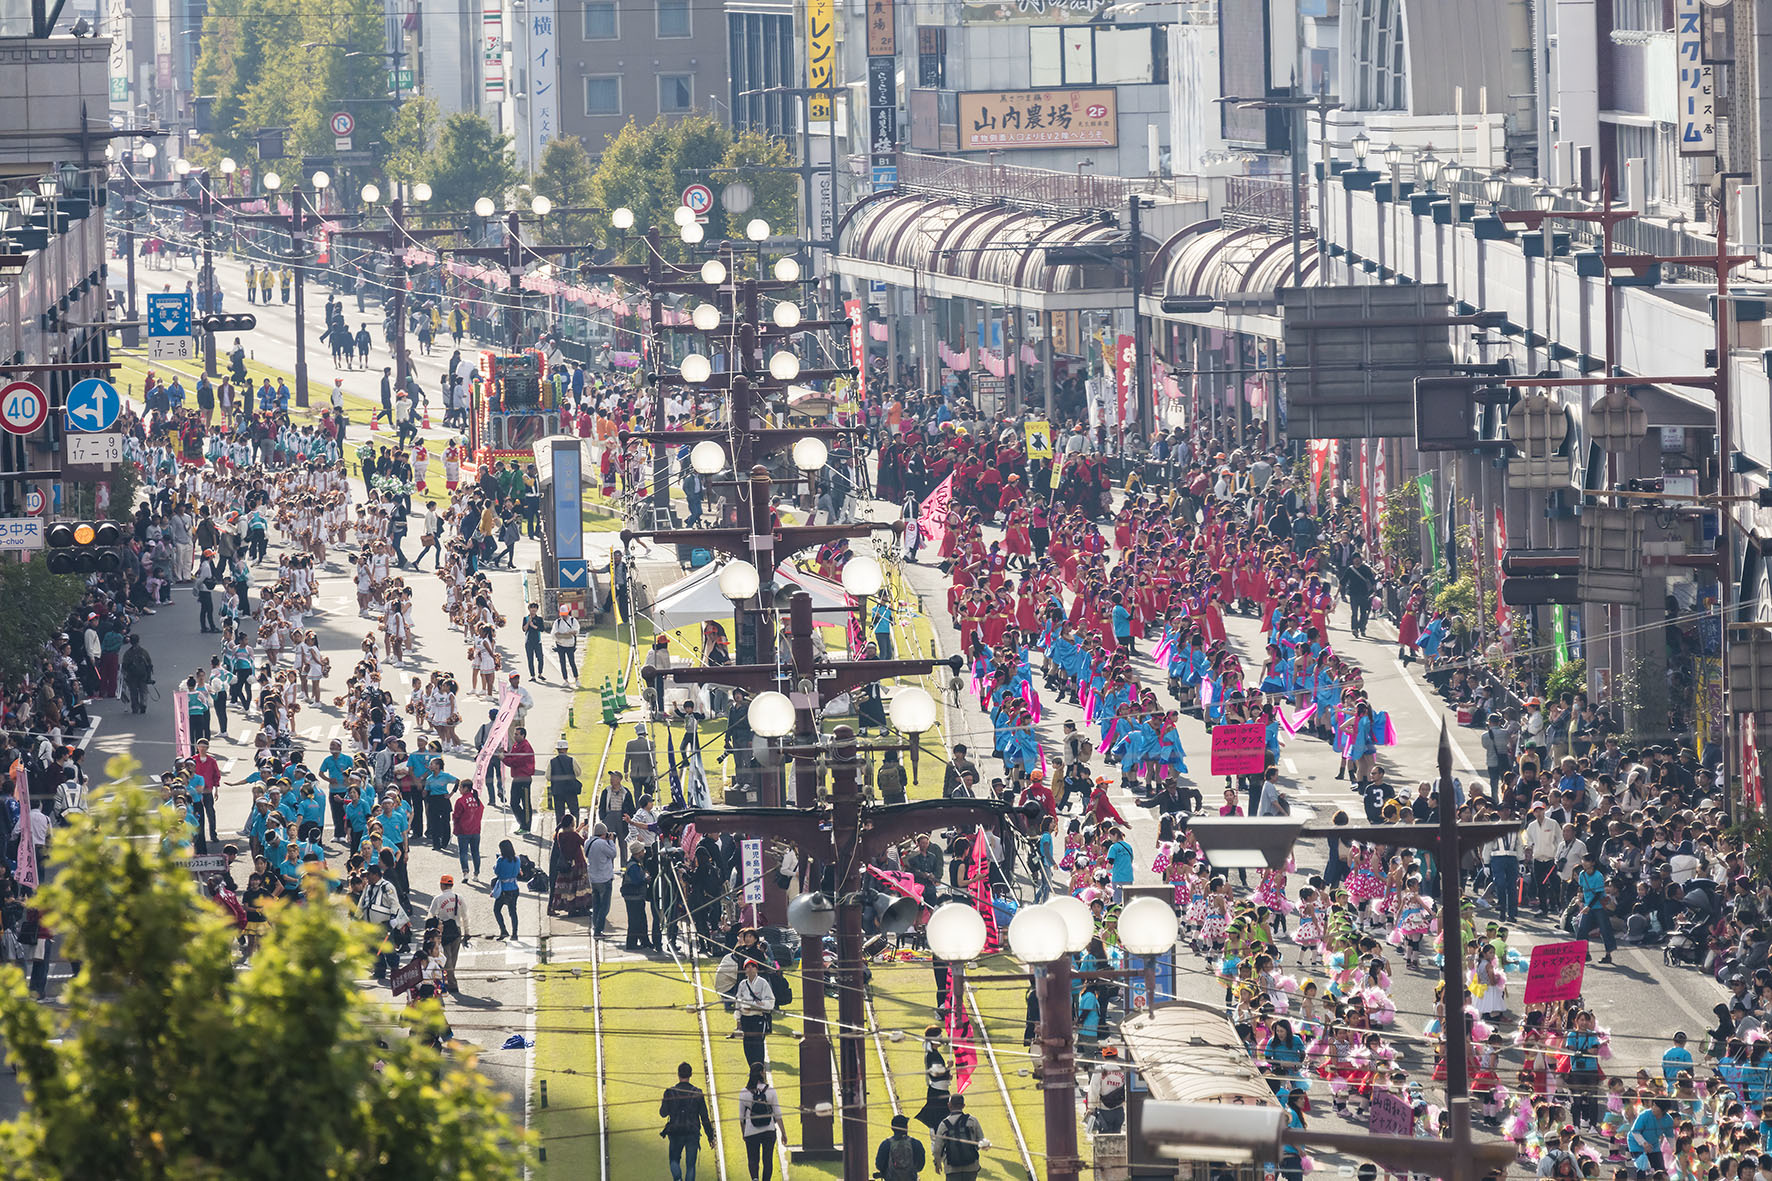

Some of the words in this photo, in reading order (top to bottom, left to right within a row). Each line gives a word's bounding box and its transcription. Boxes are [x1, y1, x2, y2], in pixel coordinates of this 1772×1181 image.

[533, 0, 553, 95] 横イン
[974, 104, 1072, 132] 山内農場
[1088, 106, 1105, 118] 2F
[878, 157, 890, 166] B1
[7, 396, 36, 420] 40
[1372, 788, 1384, 808] 3
